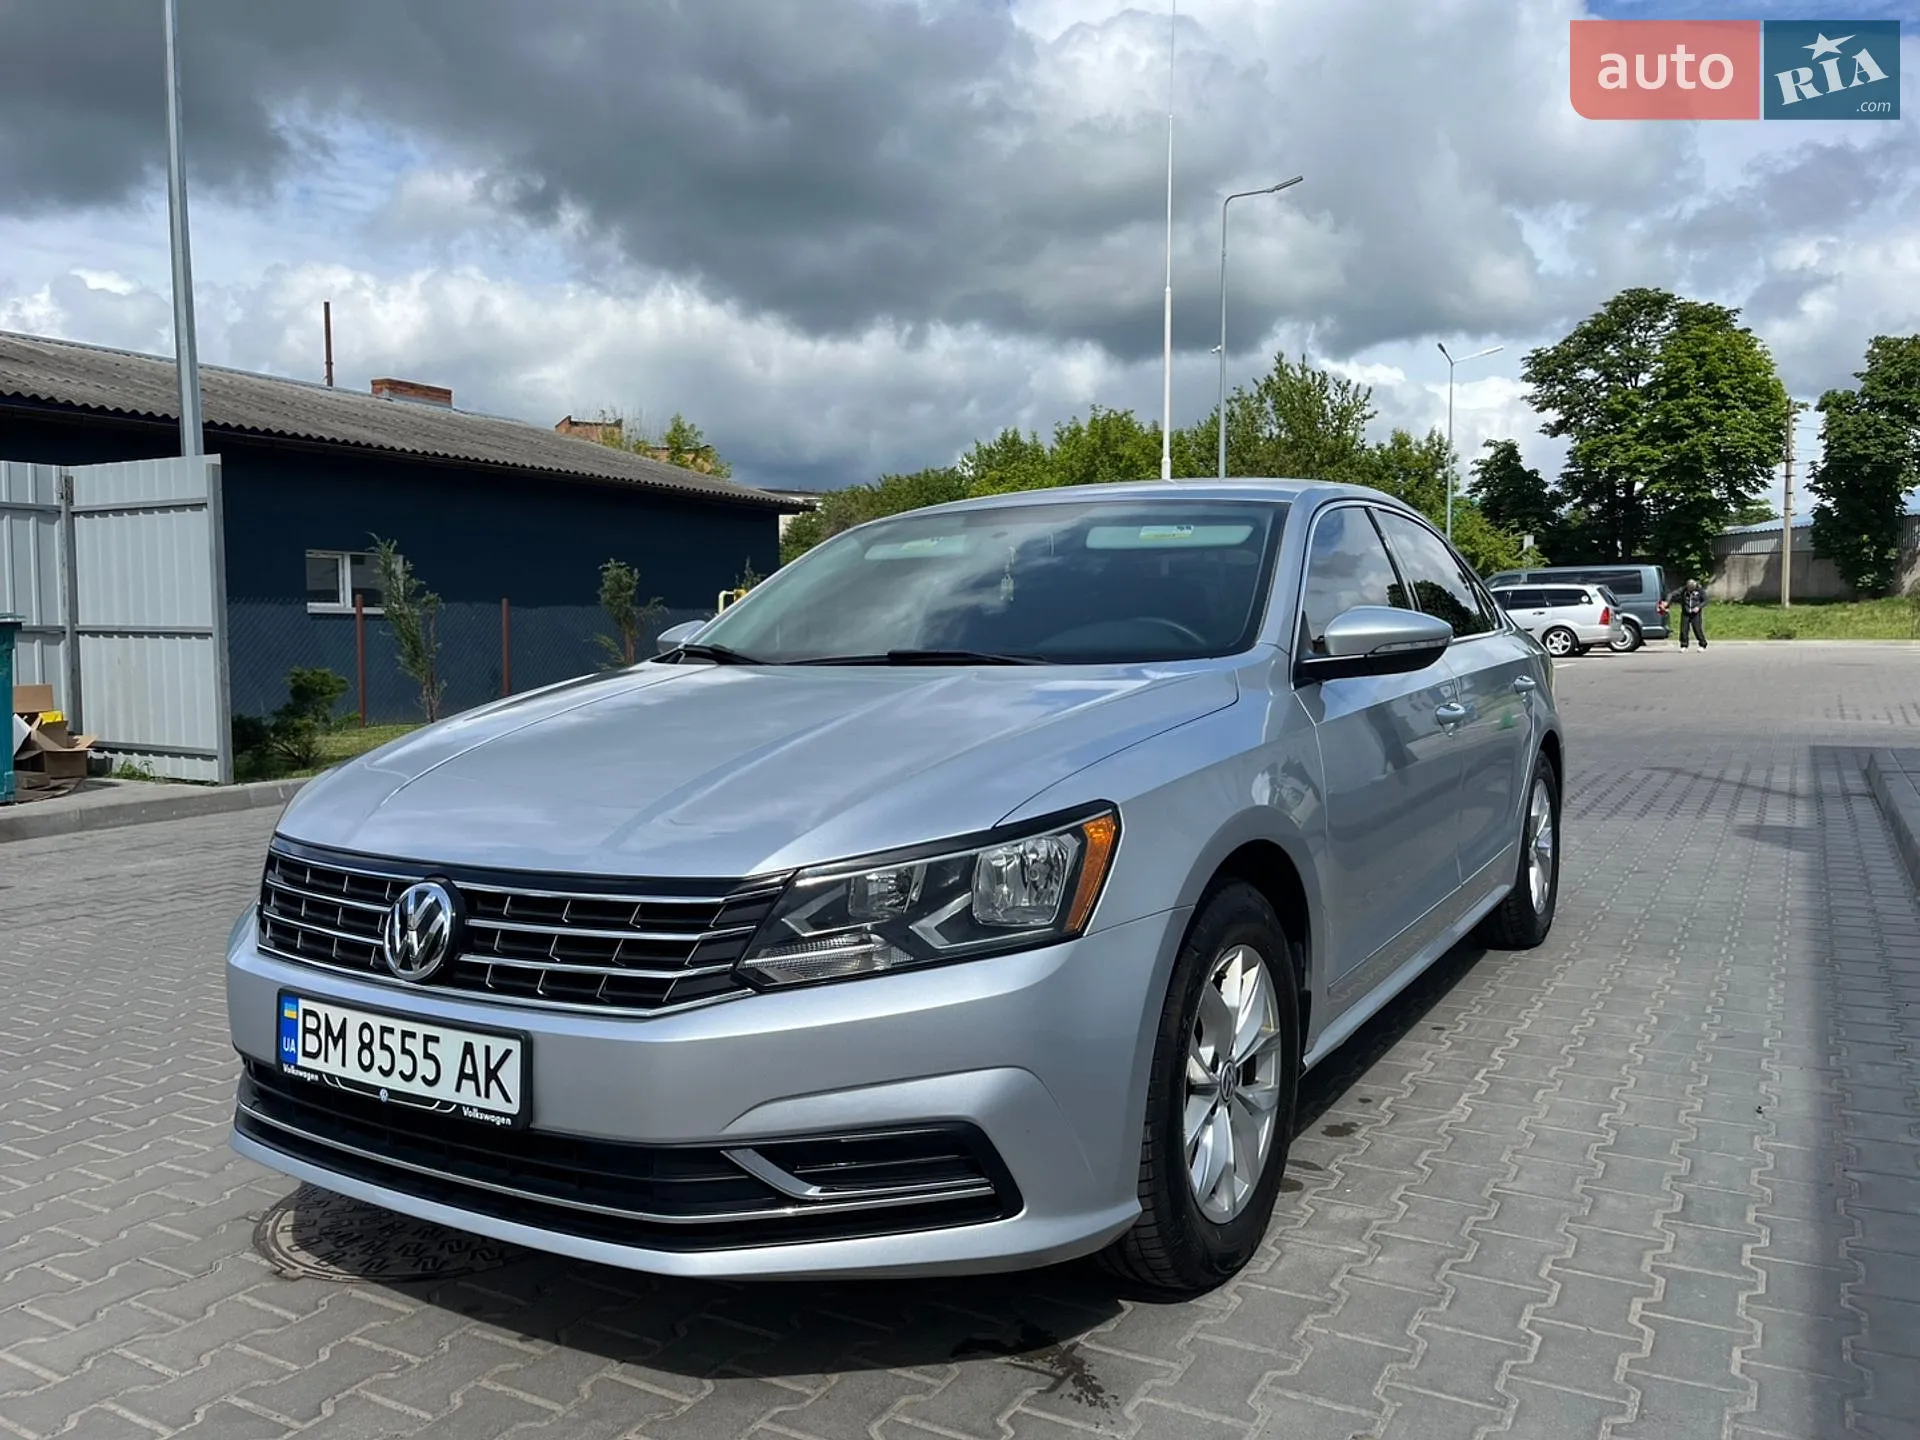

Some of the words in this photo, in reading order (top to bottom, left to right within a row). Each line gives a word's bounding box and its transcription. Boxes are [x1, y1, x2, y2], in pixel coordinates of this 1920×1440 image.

[283, 1036, 297, 1054] UA
[302, 1007, 347, 1068] BM
[357, 1021, 442, 1088] 8555
[454, 1040, 513, 1104] AK
[282, 1063, 320, 1083] Volkswagen
[462, 1105, 512, 1127] Volkswagen
